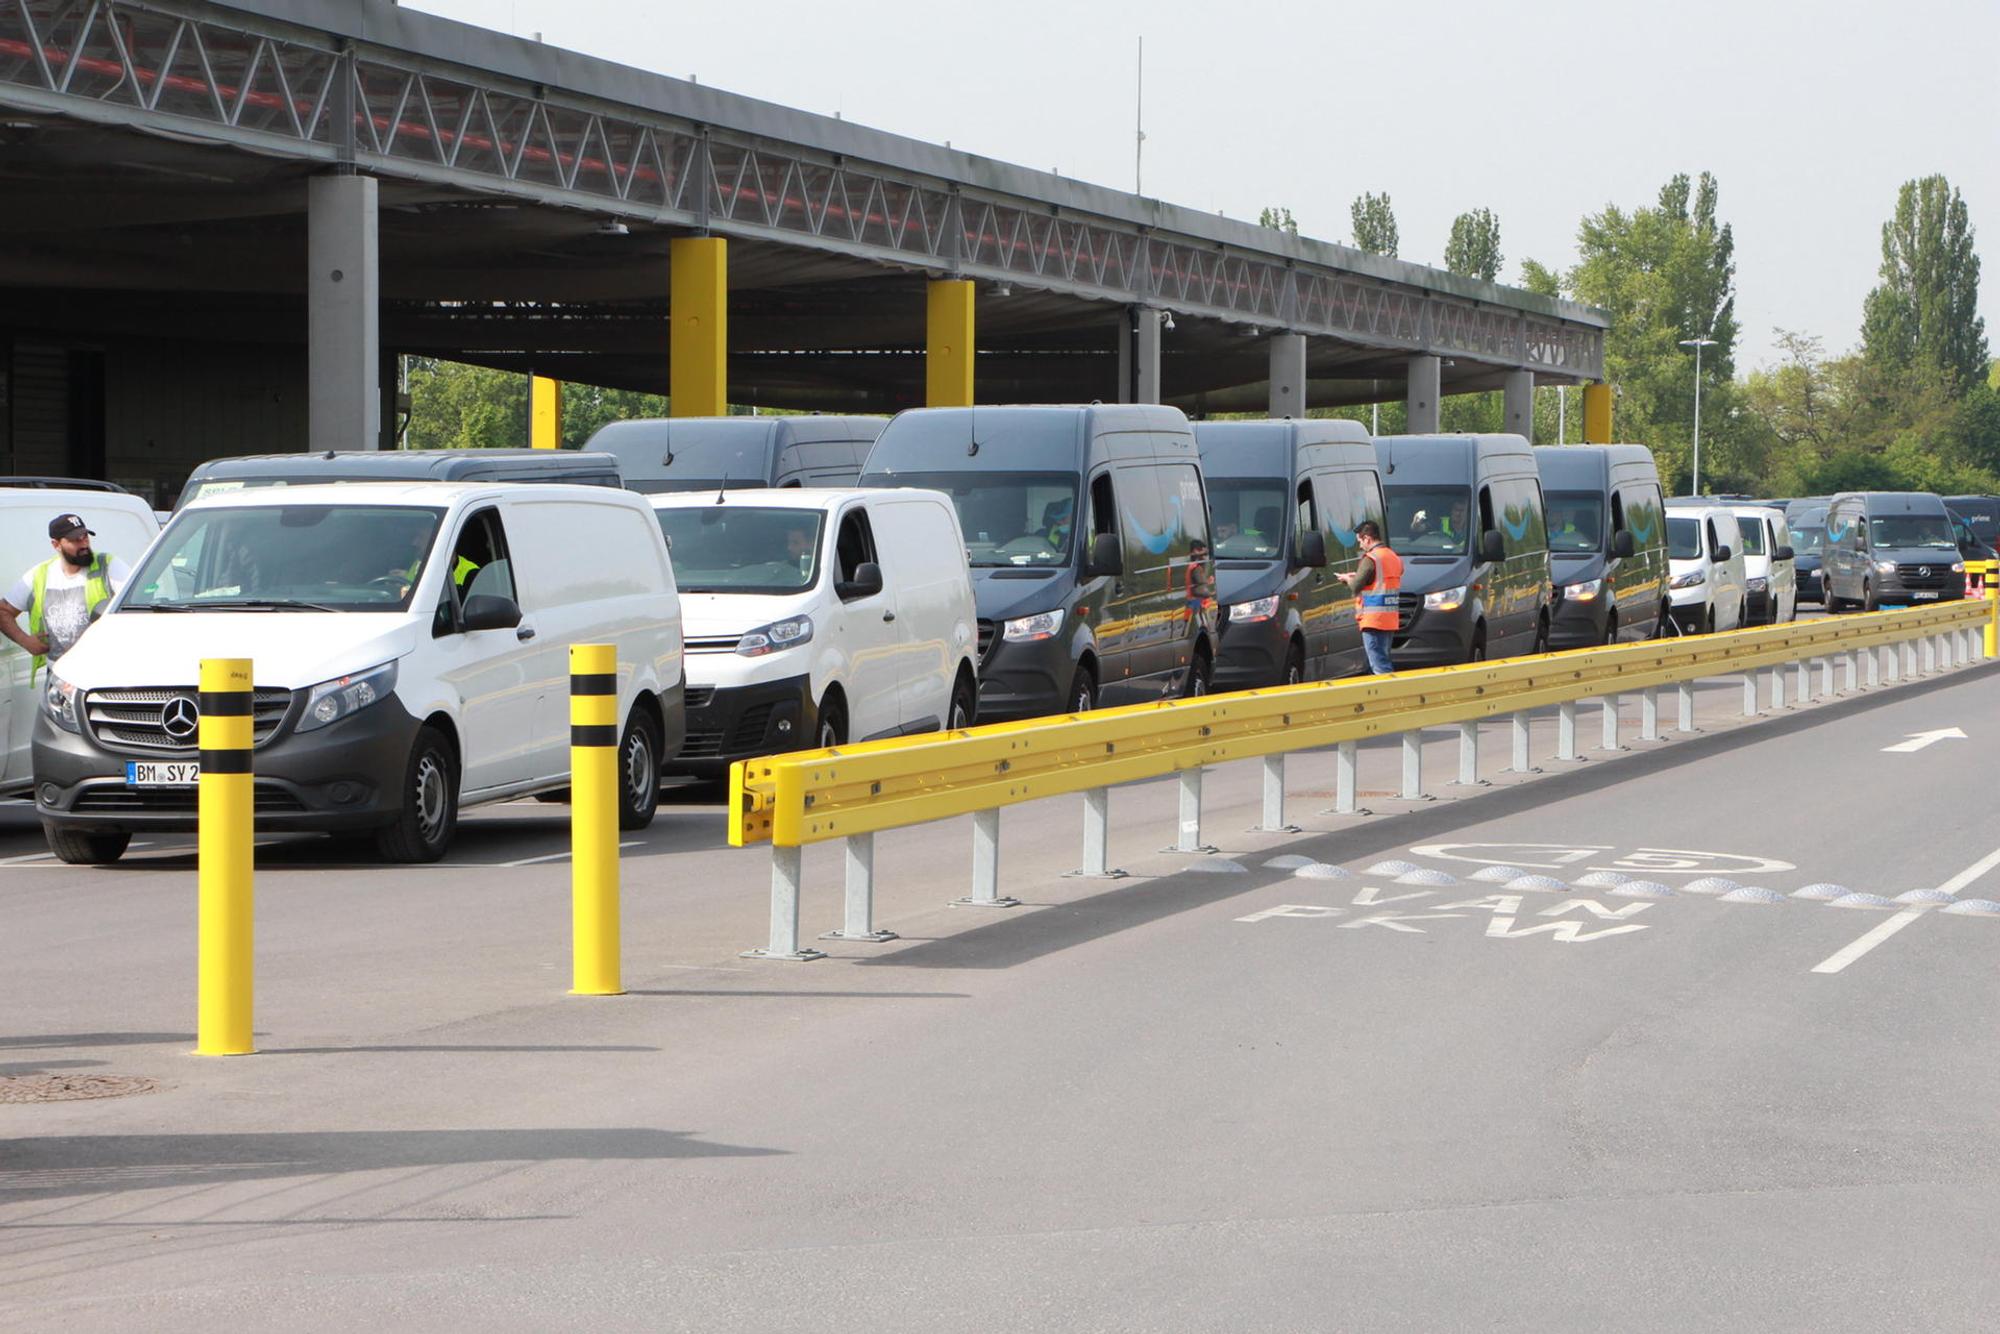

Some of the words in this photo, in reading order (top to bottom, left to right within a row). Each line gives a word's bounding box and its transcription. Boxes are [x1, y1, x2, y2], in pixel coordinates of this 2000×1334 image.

[137, 765, 156, 782] BM
[167, 765, 186, 782] SY
[1351, 887, 1656, 919] VAN
[1232, 904, 1650, 943] PKW
